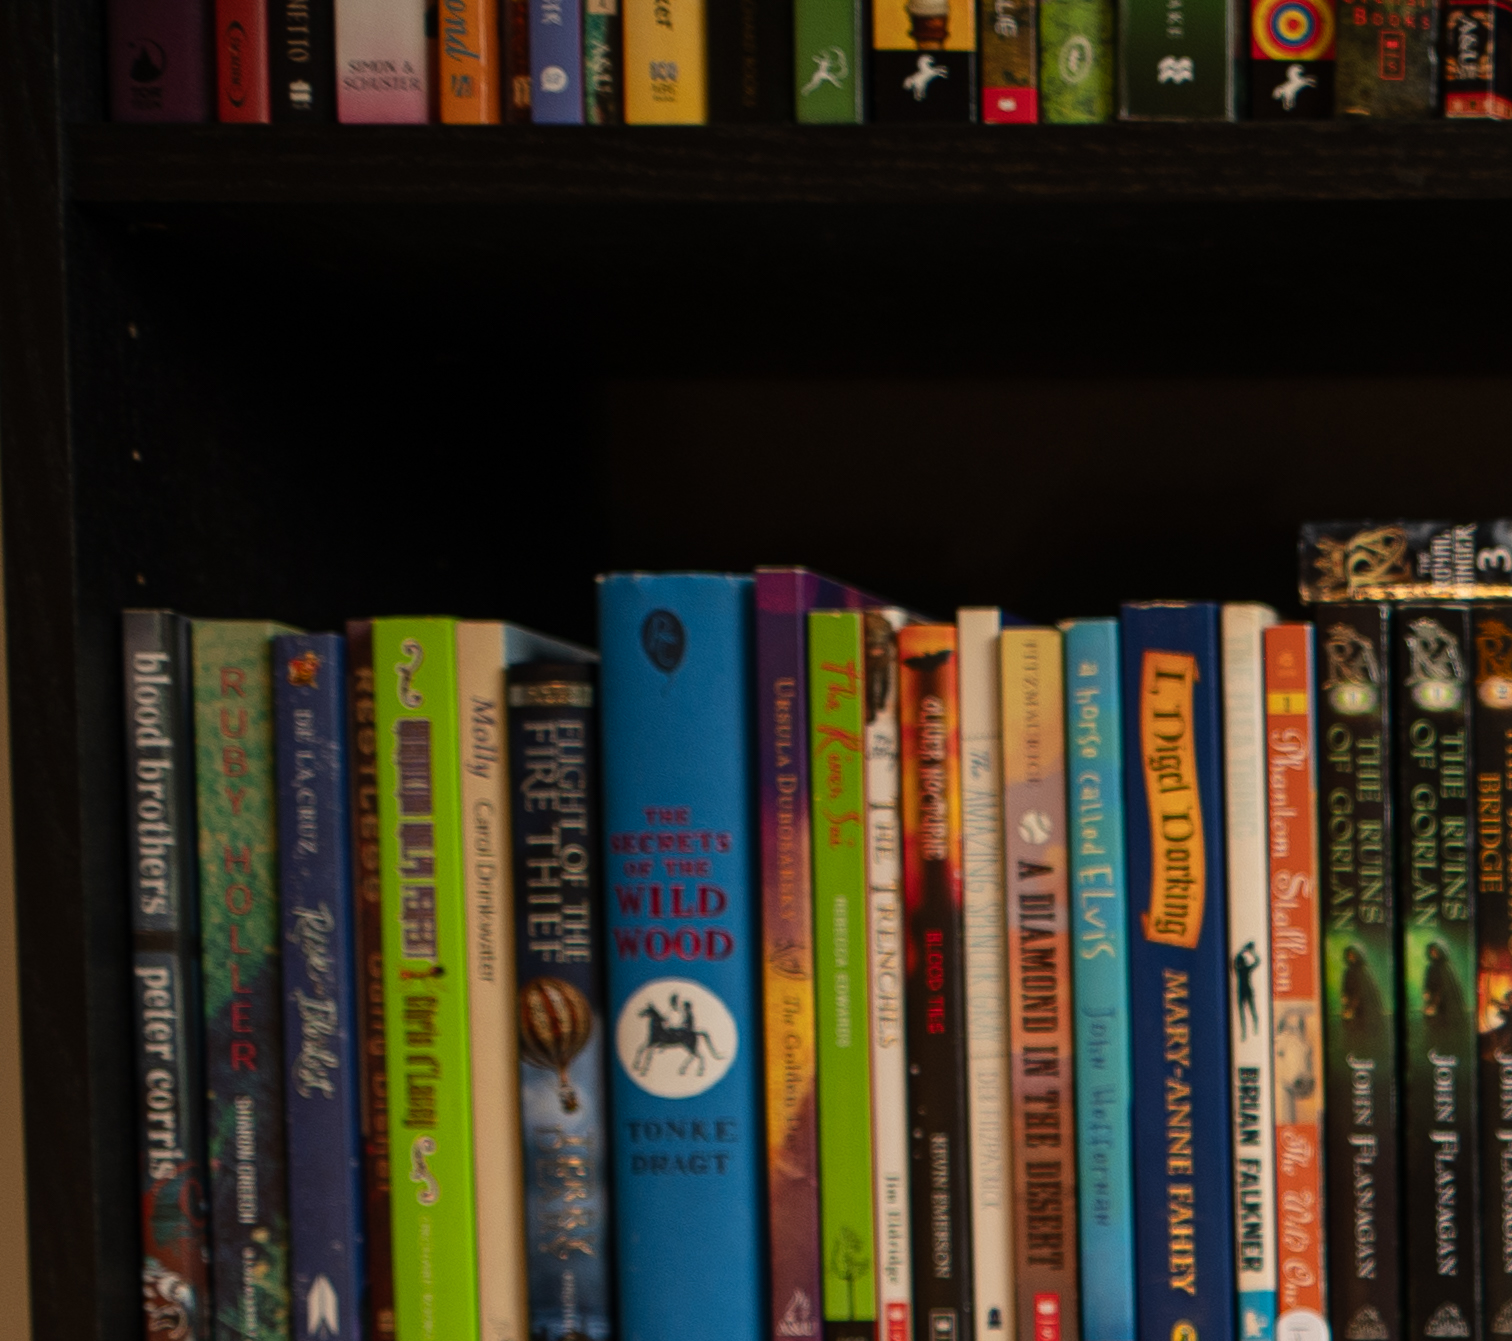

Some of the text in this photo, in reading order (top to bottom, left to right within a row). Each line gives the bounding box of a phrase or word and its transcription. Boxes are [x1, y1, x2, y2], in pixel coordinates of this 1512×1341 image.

[135, 651, 175, 915] blood brothers
[135, 968, 182, 1182] peter corris
[1238, 1066, 1264, 1272] BRIAN FALKNER
